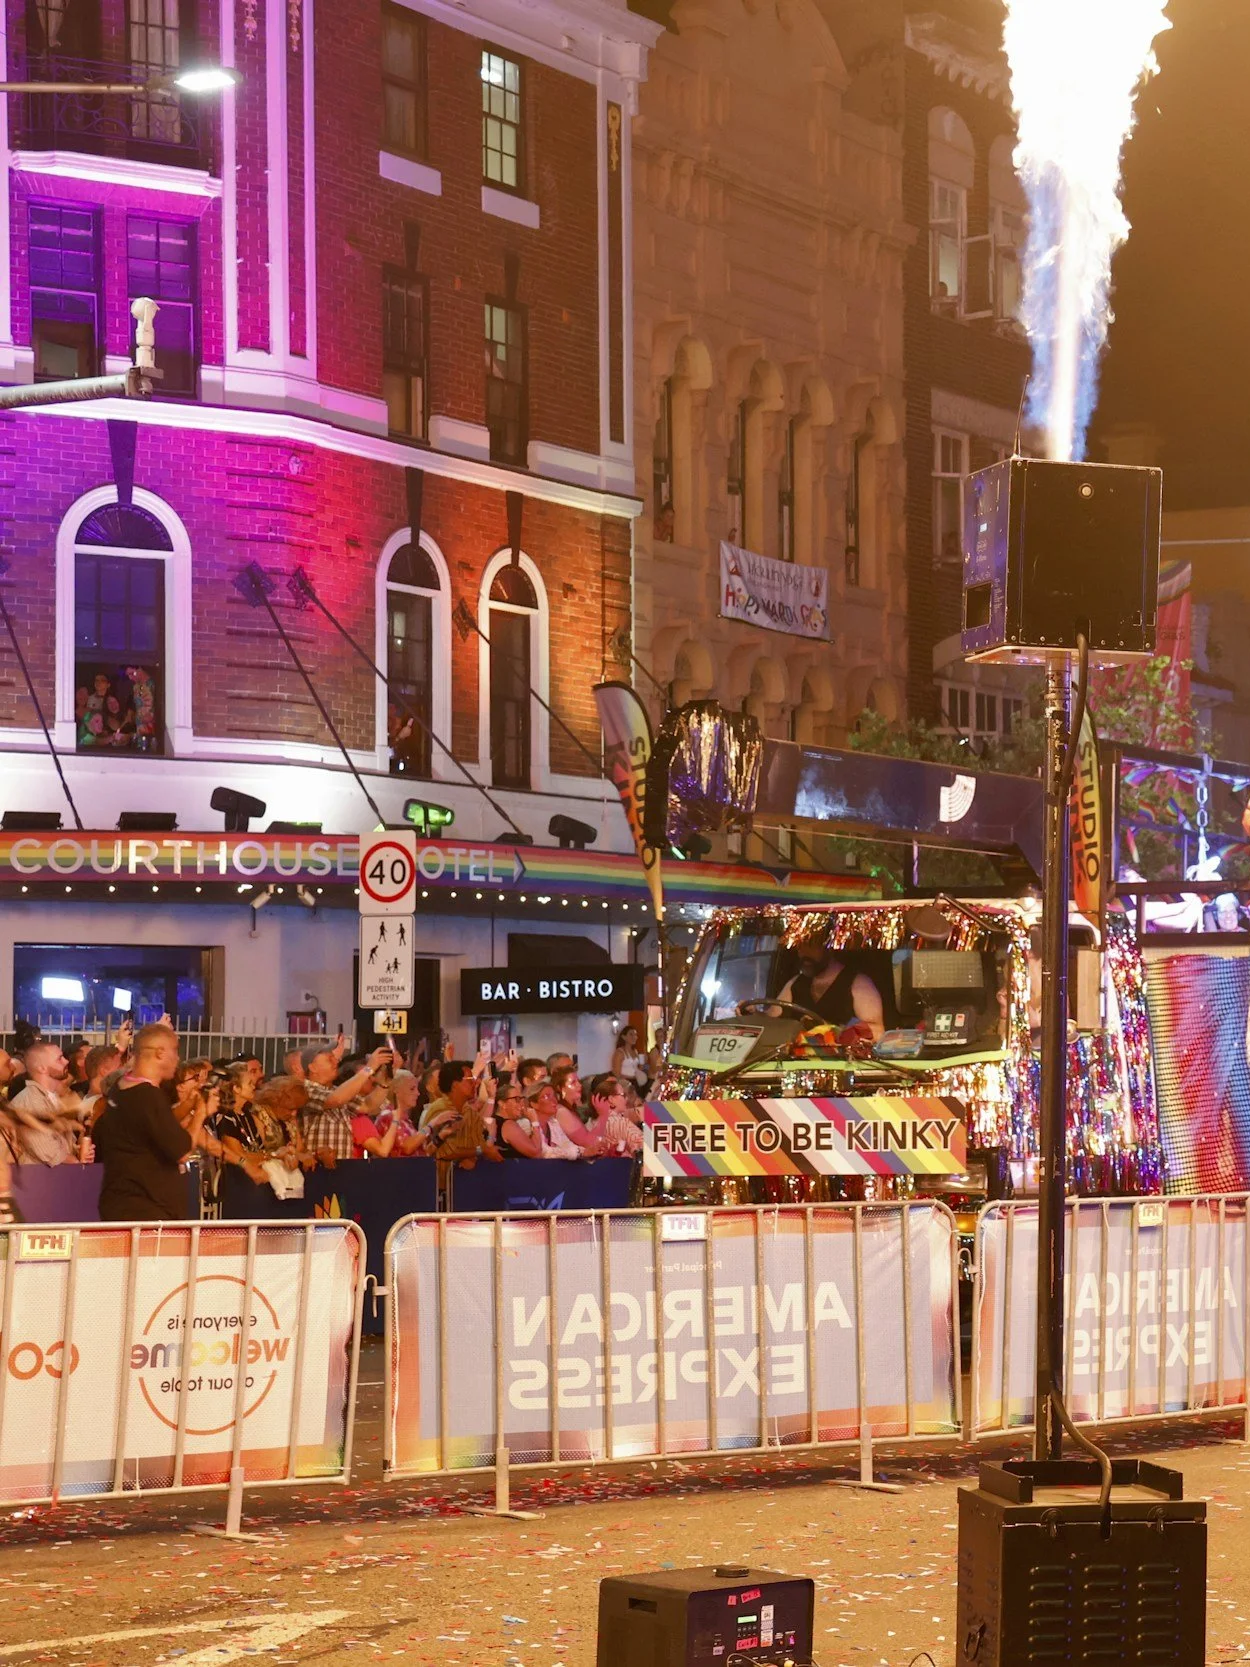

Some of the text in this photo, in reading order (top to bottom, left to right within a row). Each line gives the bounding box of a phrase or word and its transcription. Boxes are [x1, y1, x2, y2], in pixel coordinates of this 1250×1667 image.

[629, 736, 657, 870] STUDO
[1078, 741, 1100, 882] STUDIO
[9, 838, 503, 883] COURTHOUSE OTEL
[368, 859, 407, 885] 40
[481, 979, 613, 1000] BAR BISTRO
[709, 1037, 737, 1053] F09
[651, 1119, 957, 1153] FREE TO BE KINKY
[27, 1234, 64, 1250] TFH
